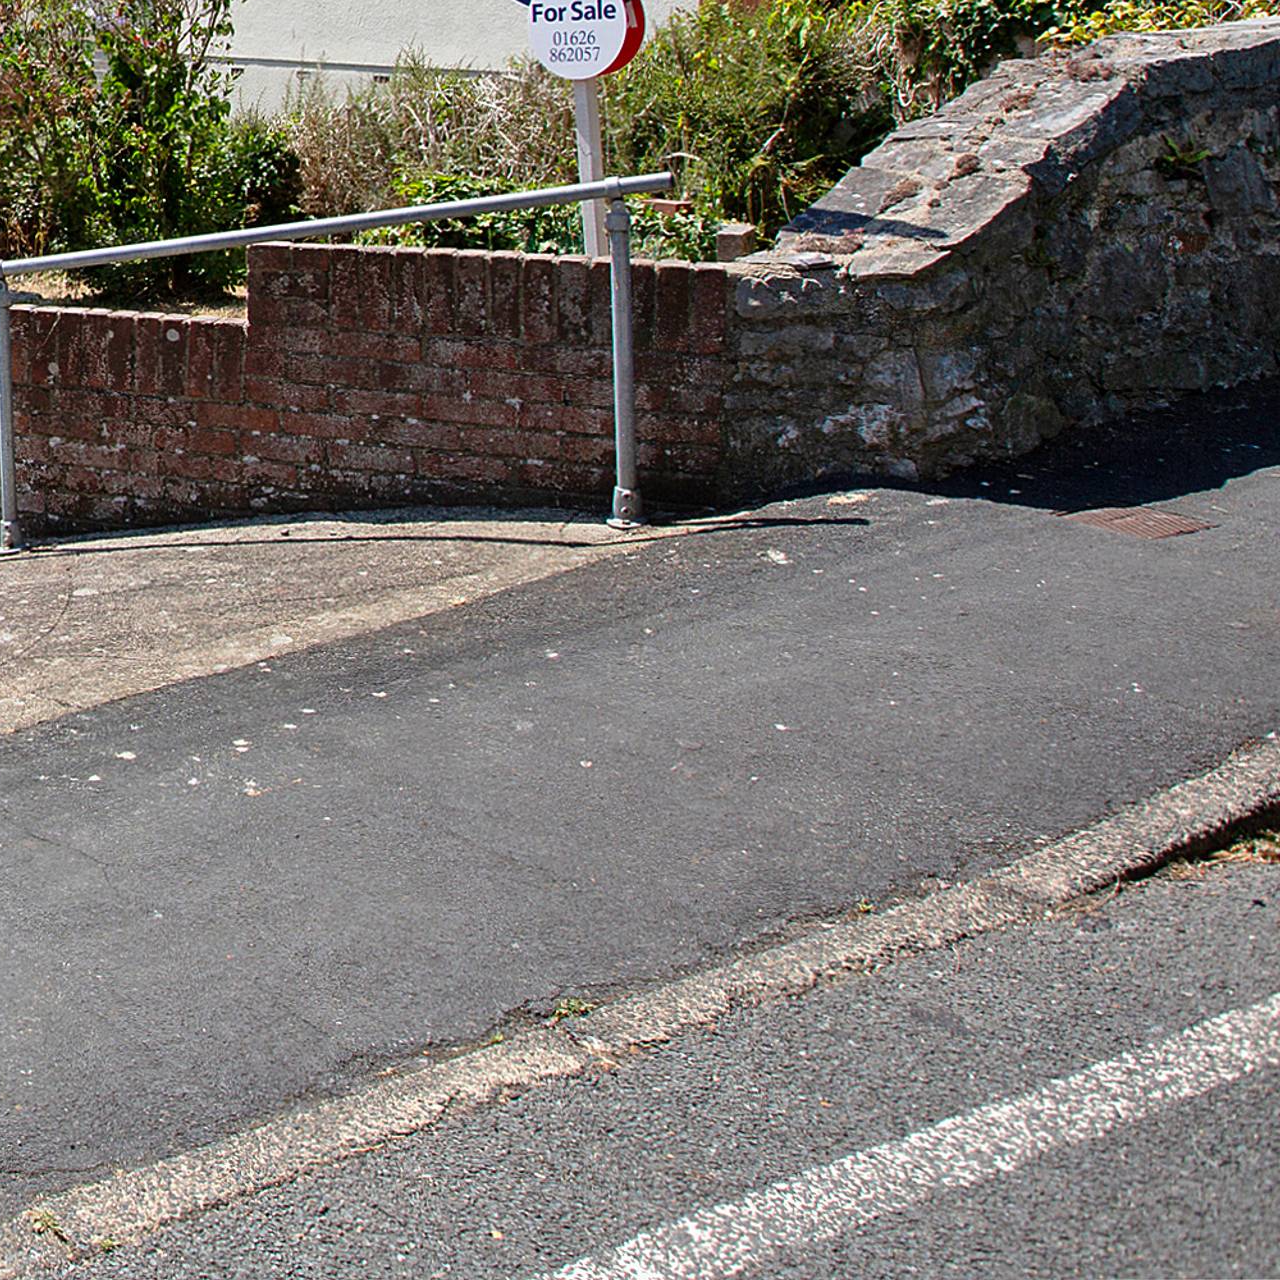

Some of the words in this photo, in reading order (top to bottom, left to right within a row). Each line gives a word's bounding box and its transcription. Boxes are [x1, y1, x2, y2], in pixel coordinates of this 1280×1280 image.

[531, 3, 567, 23] For
[553, 31, 596, 46] 01626
[550, 47, 600, 62] 862057
